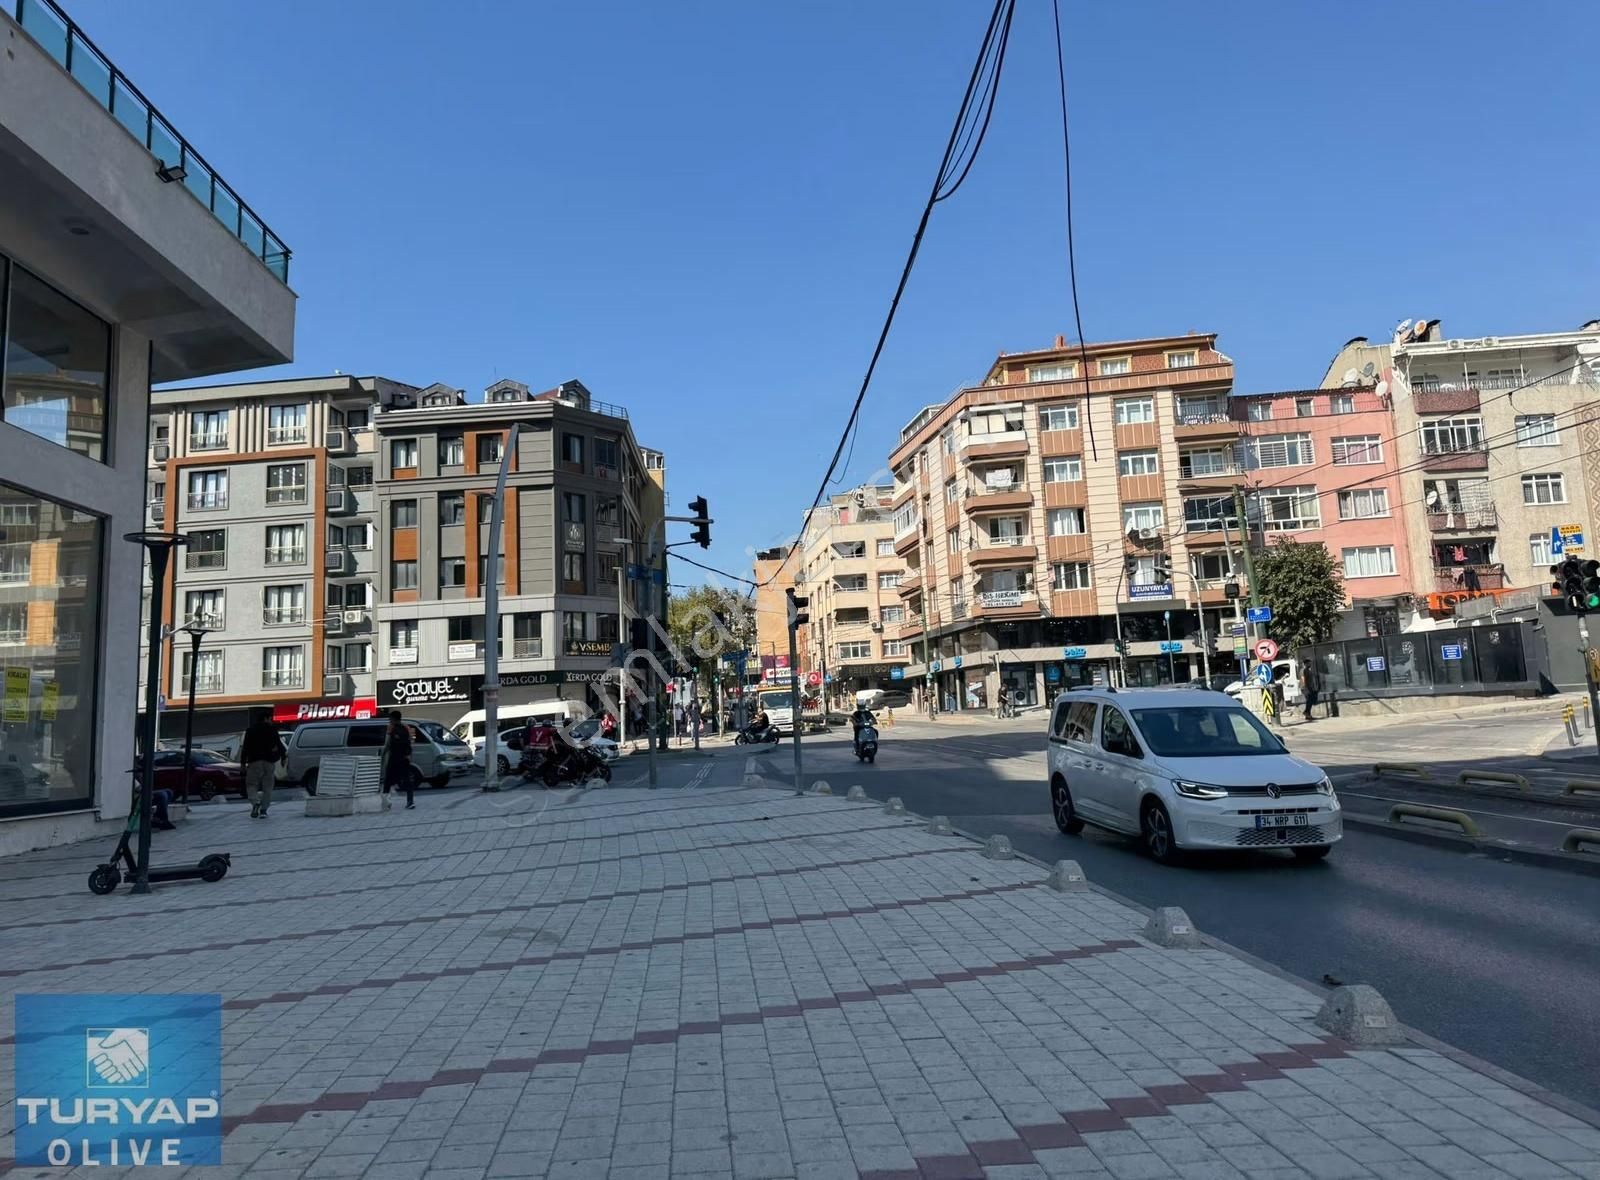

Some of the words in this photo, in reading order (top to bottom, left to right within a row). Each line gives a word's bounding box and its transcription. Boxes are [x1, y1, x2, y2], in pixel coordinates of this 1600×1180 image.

[1131, 584, 1169, 593] UZUNYAYLA
[520, 674, 548, 684] GOLD
[1261, 816, 1271, 826] 34
[1274, 816, 1289, 826] NRP
